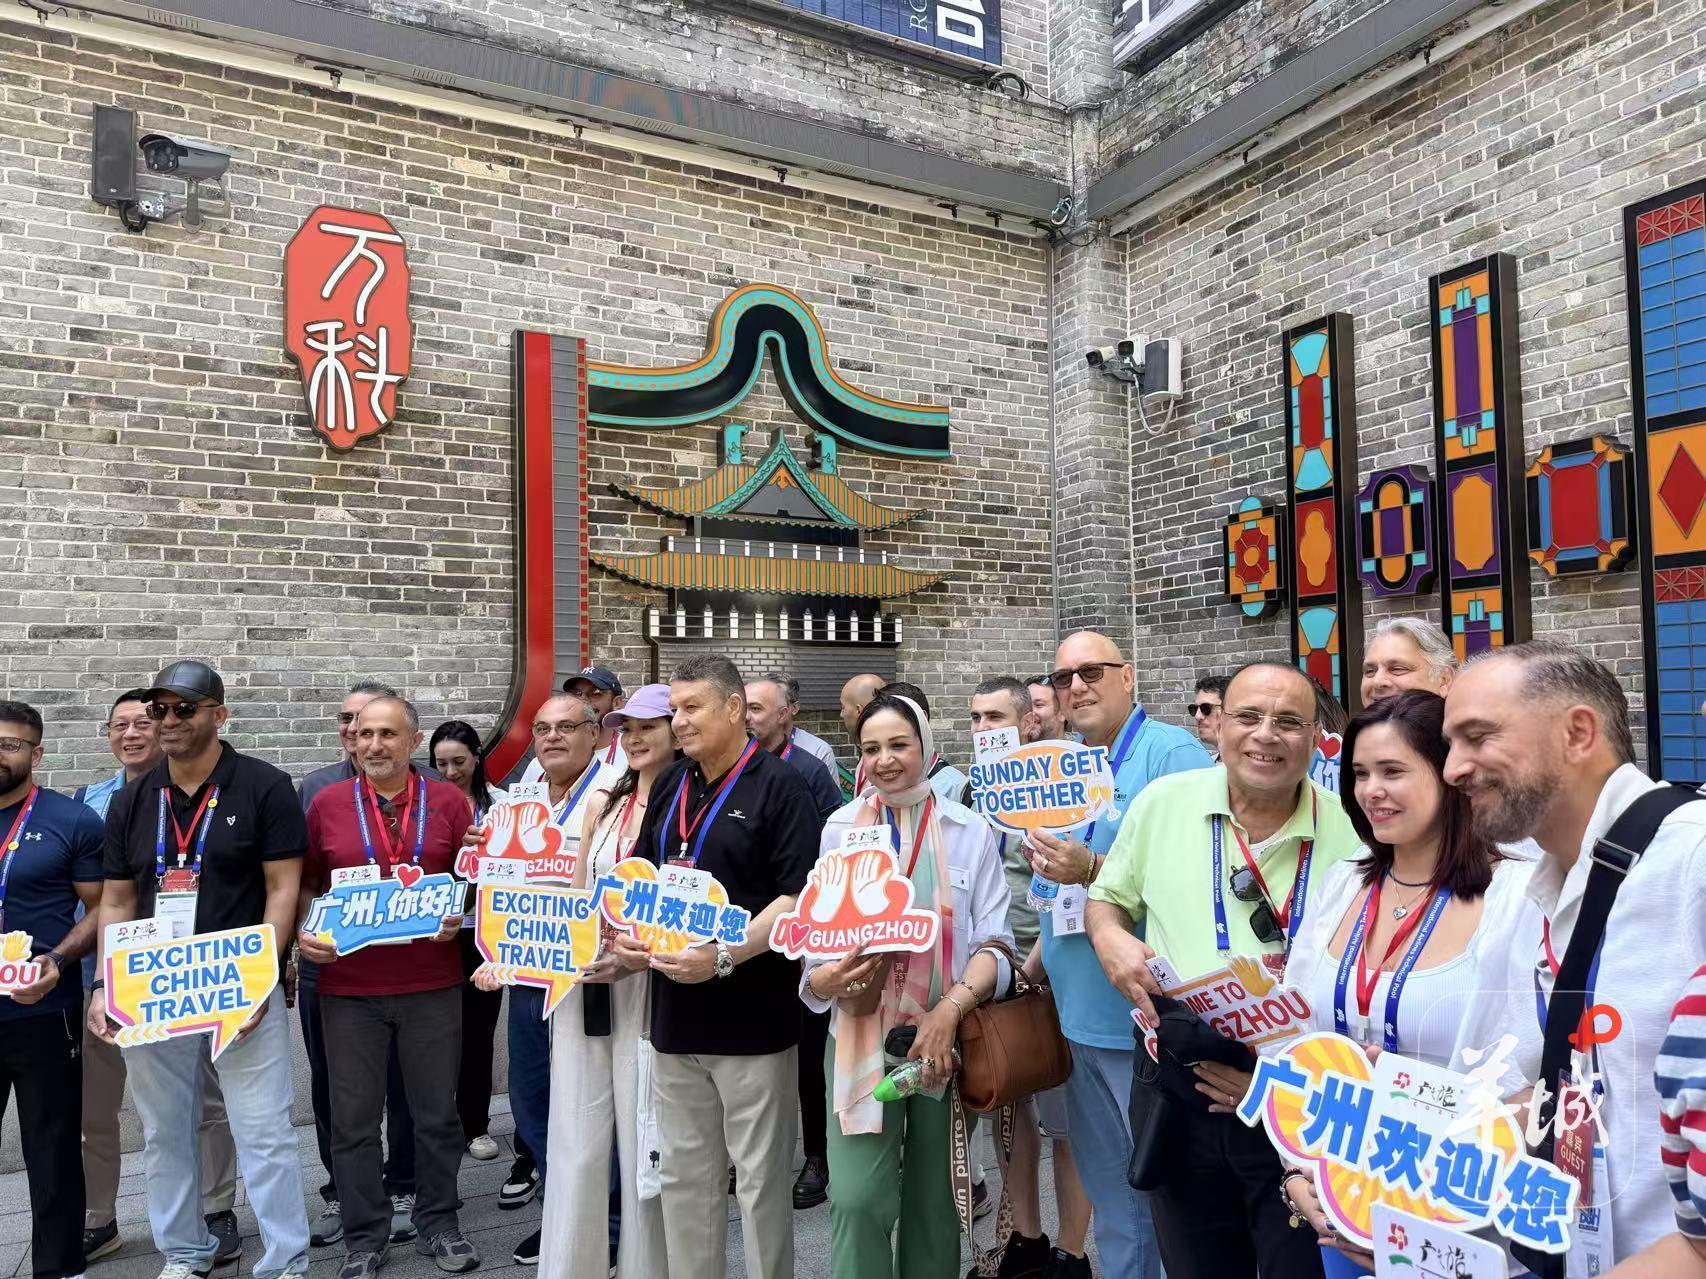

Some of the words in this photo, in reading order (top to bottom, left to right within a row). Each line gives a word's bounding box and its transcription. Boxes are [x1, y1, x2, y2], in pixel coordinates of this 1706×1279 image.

[304, 222, 406, 432] 万科
[970, 755, 1052, 787] SUNDAY
[1060, 748, 1105, 776] GET
[972, 781, 1087, 813] TOGETHER
[525, 858, 575, 874] GZHOU
[492, 890, 589, 919] EXCITING
[589, 875, 747, 942] 广州欢迎您
[1422, 896, 1445, 932] International
[505, 918, 570, 944] CHINA
[777, 923, 787, 941] I
[809, 919, 928, 947] GUANGZHOU
[1410, 932, 1427, 956] Airlines
[128, 932, 262, 974] EXCITING
[498, 943, 577, 972] TRAVEL
[1338, 946, 1355, 985] International
[150, 962, 241, 995] CHINA
[1213, 981, 1246, 1004] TO
[1390, 982, 1400, 998] Pool
[140, 986, 252, 1023] TRAVEL
[1210, 990, 1311, 1041] GZHOU
[953, 1120, 967, 1177] pierre
[1241, 1059, 1572, 1246] 广州欢迎您
[1560, 1144, 1585, 1174] GUEST
